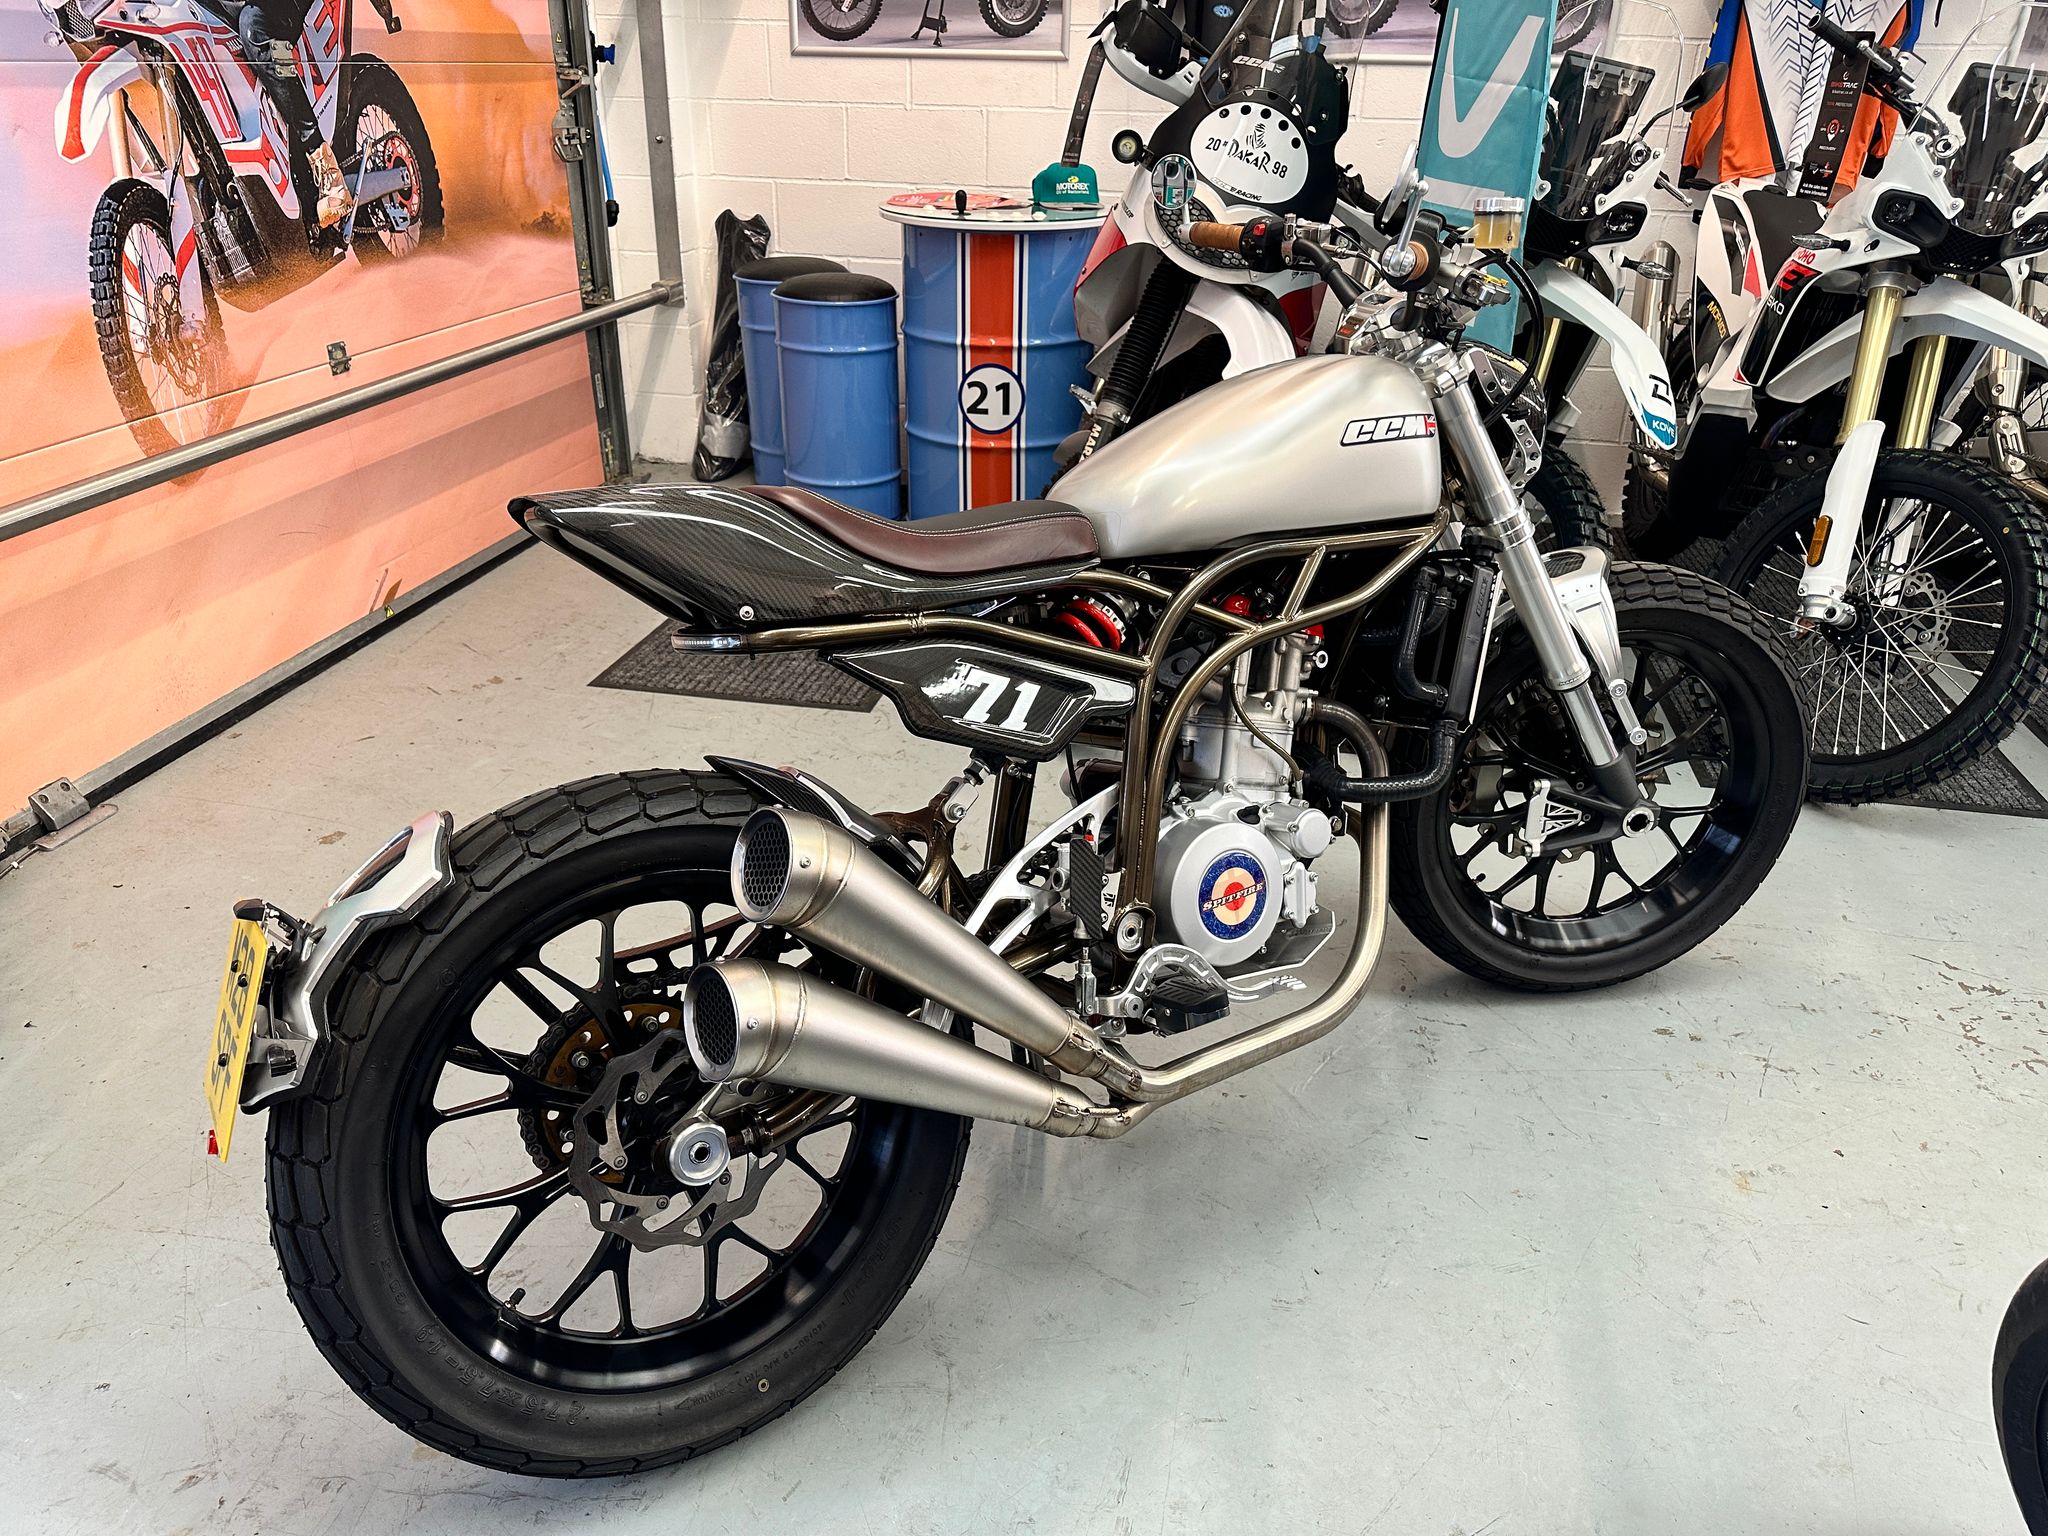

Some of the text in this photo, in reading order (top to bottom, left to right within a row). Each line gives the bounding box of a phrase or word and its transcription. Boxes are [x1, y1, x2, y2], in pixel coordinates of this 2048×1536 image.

[1227, 139, 1270, 174] DAKAR
[1272, 160, 1288, 178] 98
[1056, 182, 1090, 191] MOTOREX
[1236, 189, 1262, 201] RACING
[966, 380, 1010, 416] 21
[1342, 415, 1427, 444] CCM
[1652, 419, 1675, 438] KOVE
[963, 667, 1041, 731] 71
[1202, 882, 1263, 911] SPITFIRE
